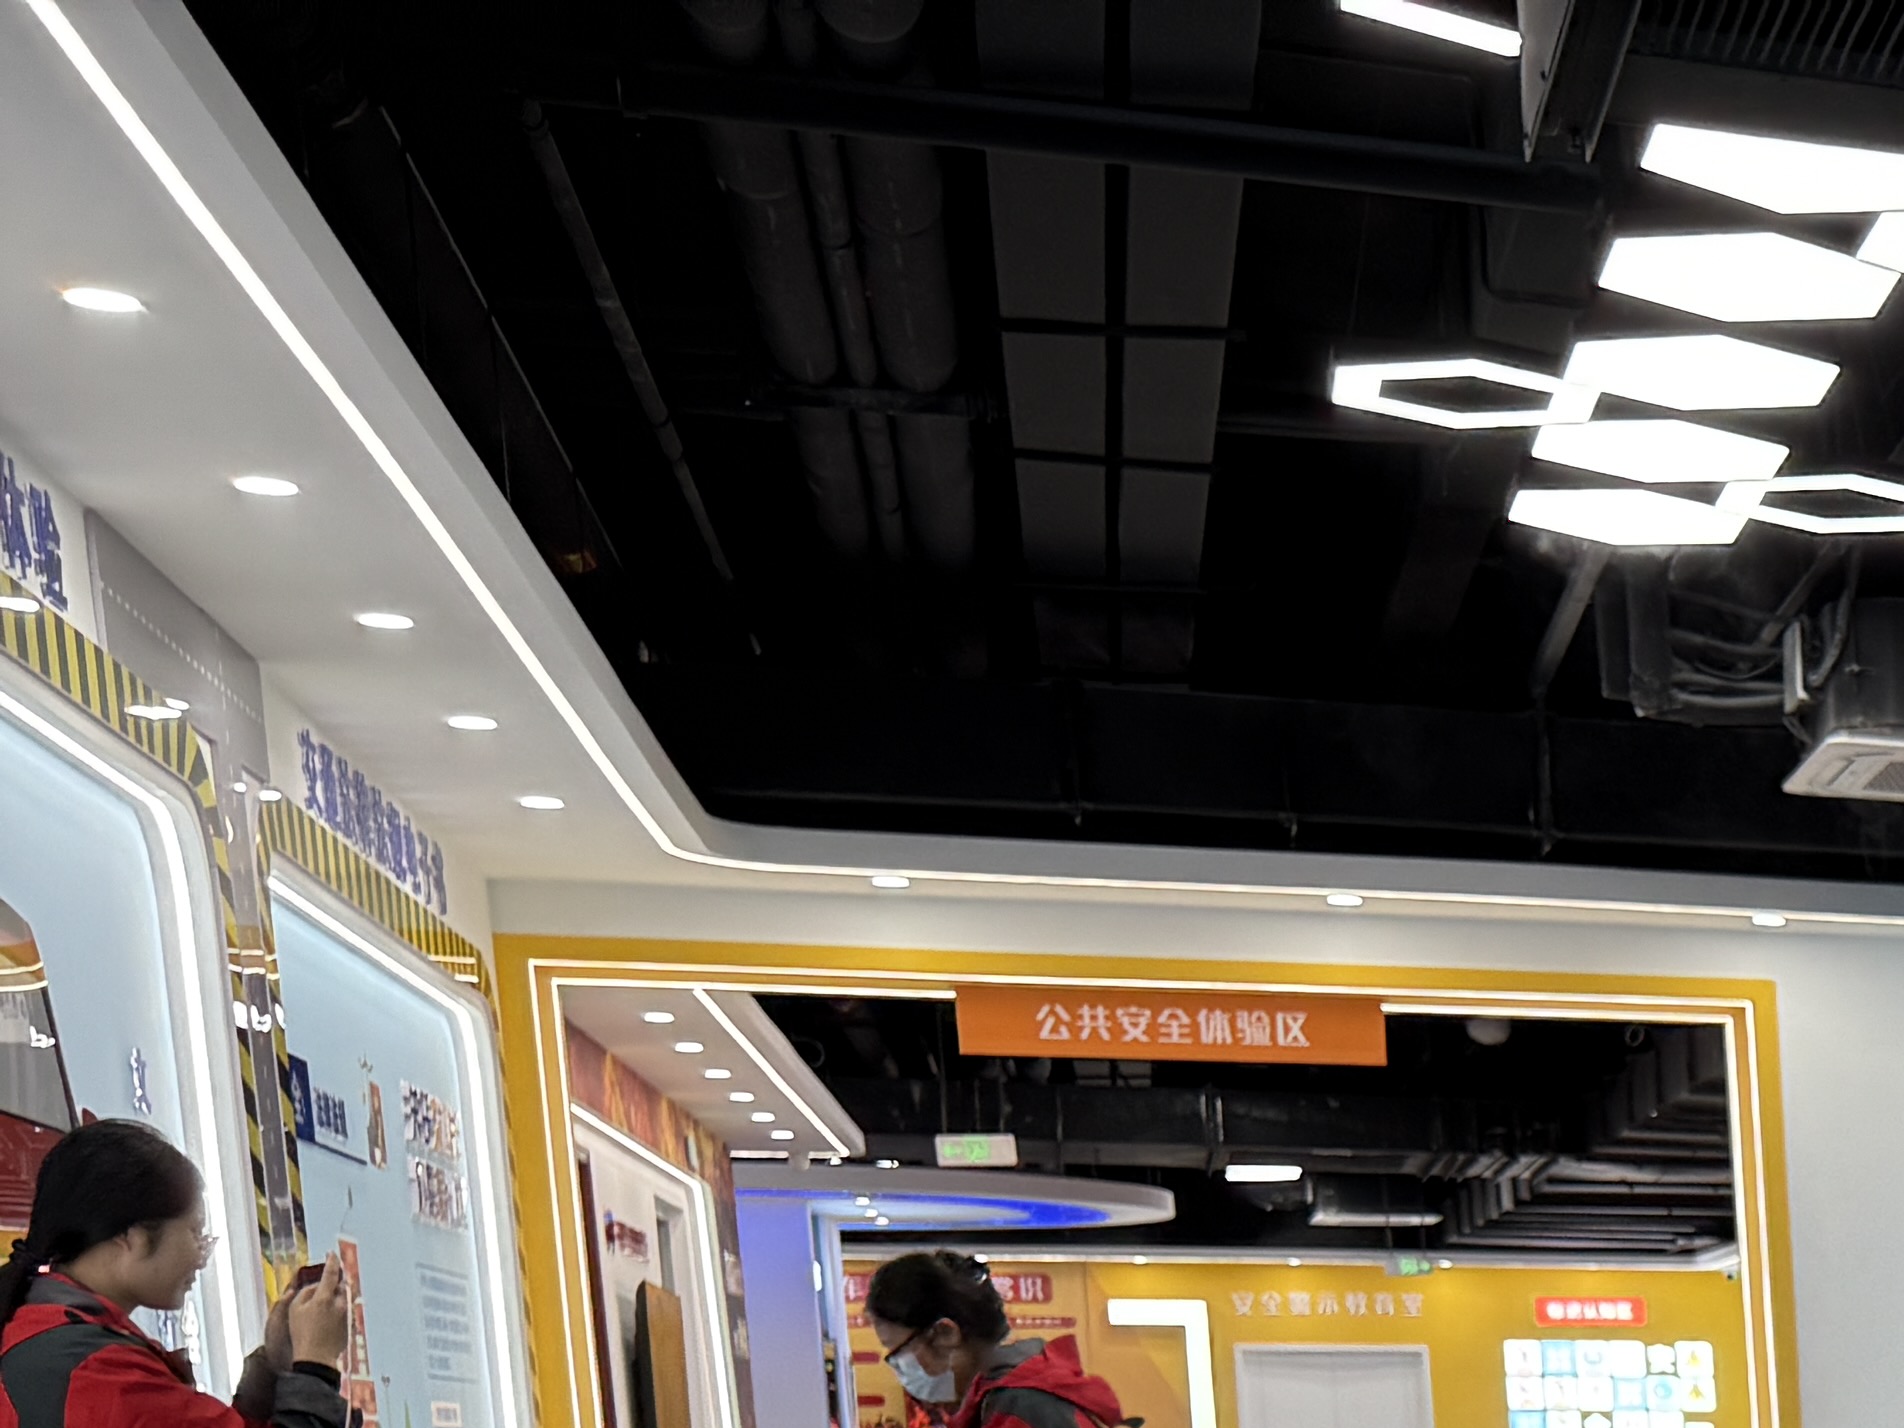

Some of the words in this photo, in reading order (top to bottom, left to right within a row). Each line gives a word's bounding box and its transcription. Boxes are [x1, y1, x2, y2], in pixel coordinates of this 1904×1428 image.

[1035, 1002, 1311, 1048] 公共安全体验区
